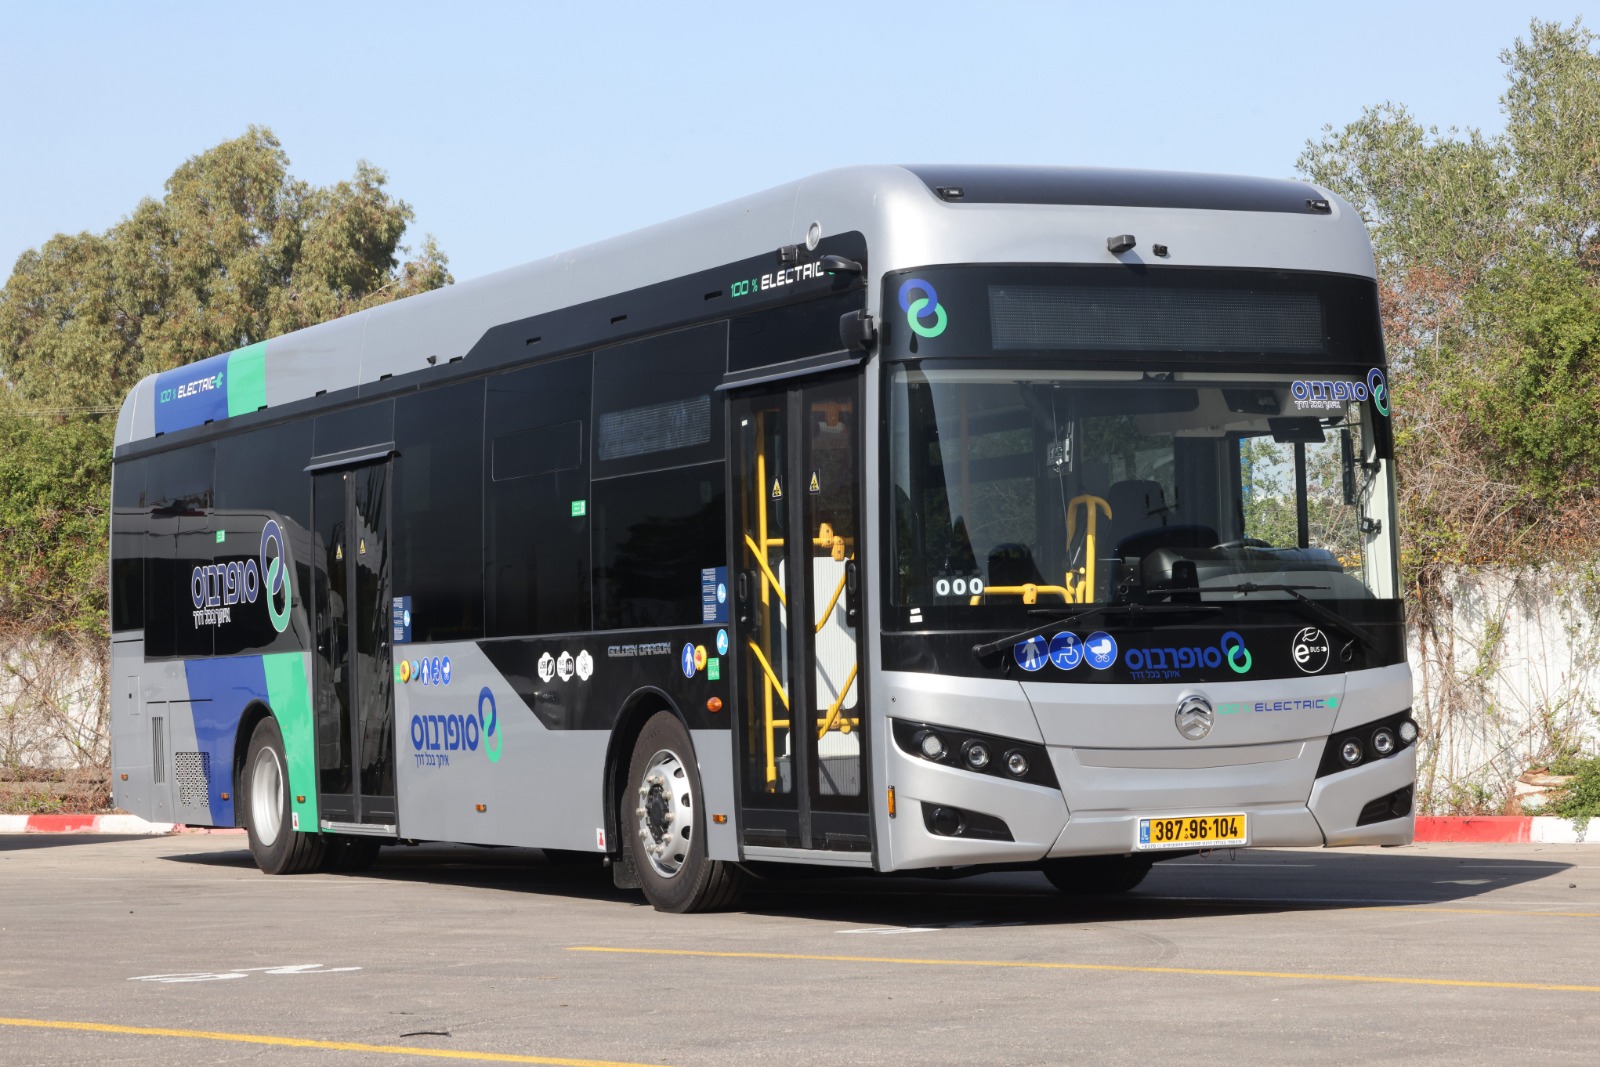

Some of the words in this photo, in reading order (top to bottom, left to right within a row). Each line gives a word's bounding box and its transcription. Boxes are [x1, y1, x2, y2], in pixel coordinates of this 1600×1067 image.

[731, 280, 749, 297] 100
[761, 261, 824, 290] ELECTRIC
[178, 376, 216, 399] ELECTRIC
[1291, 380, 1368, 401] סופרבוס
[191, 558, 259, 609] סופרבוס
[936, 578, 983, 595] 000
[608, 644, 638, 657] GOLDEN
[639, 642, 671, 656] DRAGON
[1125, 646, 1222, 670] סופרבוס
[1130, 671, 1144, 680] דרך
[1145, 670, 1160, 678] בכל
[1162, 670, 1180, 679] איתך
[1217, 703, 1239, 715] 100
[1255, 700, 1324, 712] ELECTRIC
[411, 714, 479, 751] סופרבוס
[414, 754, 424, 768] דרך
[425, 752, 436, 766] בכל
[436, 754, 449, 768] איתך
